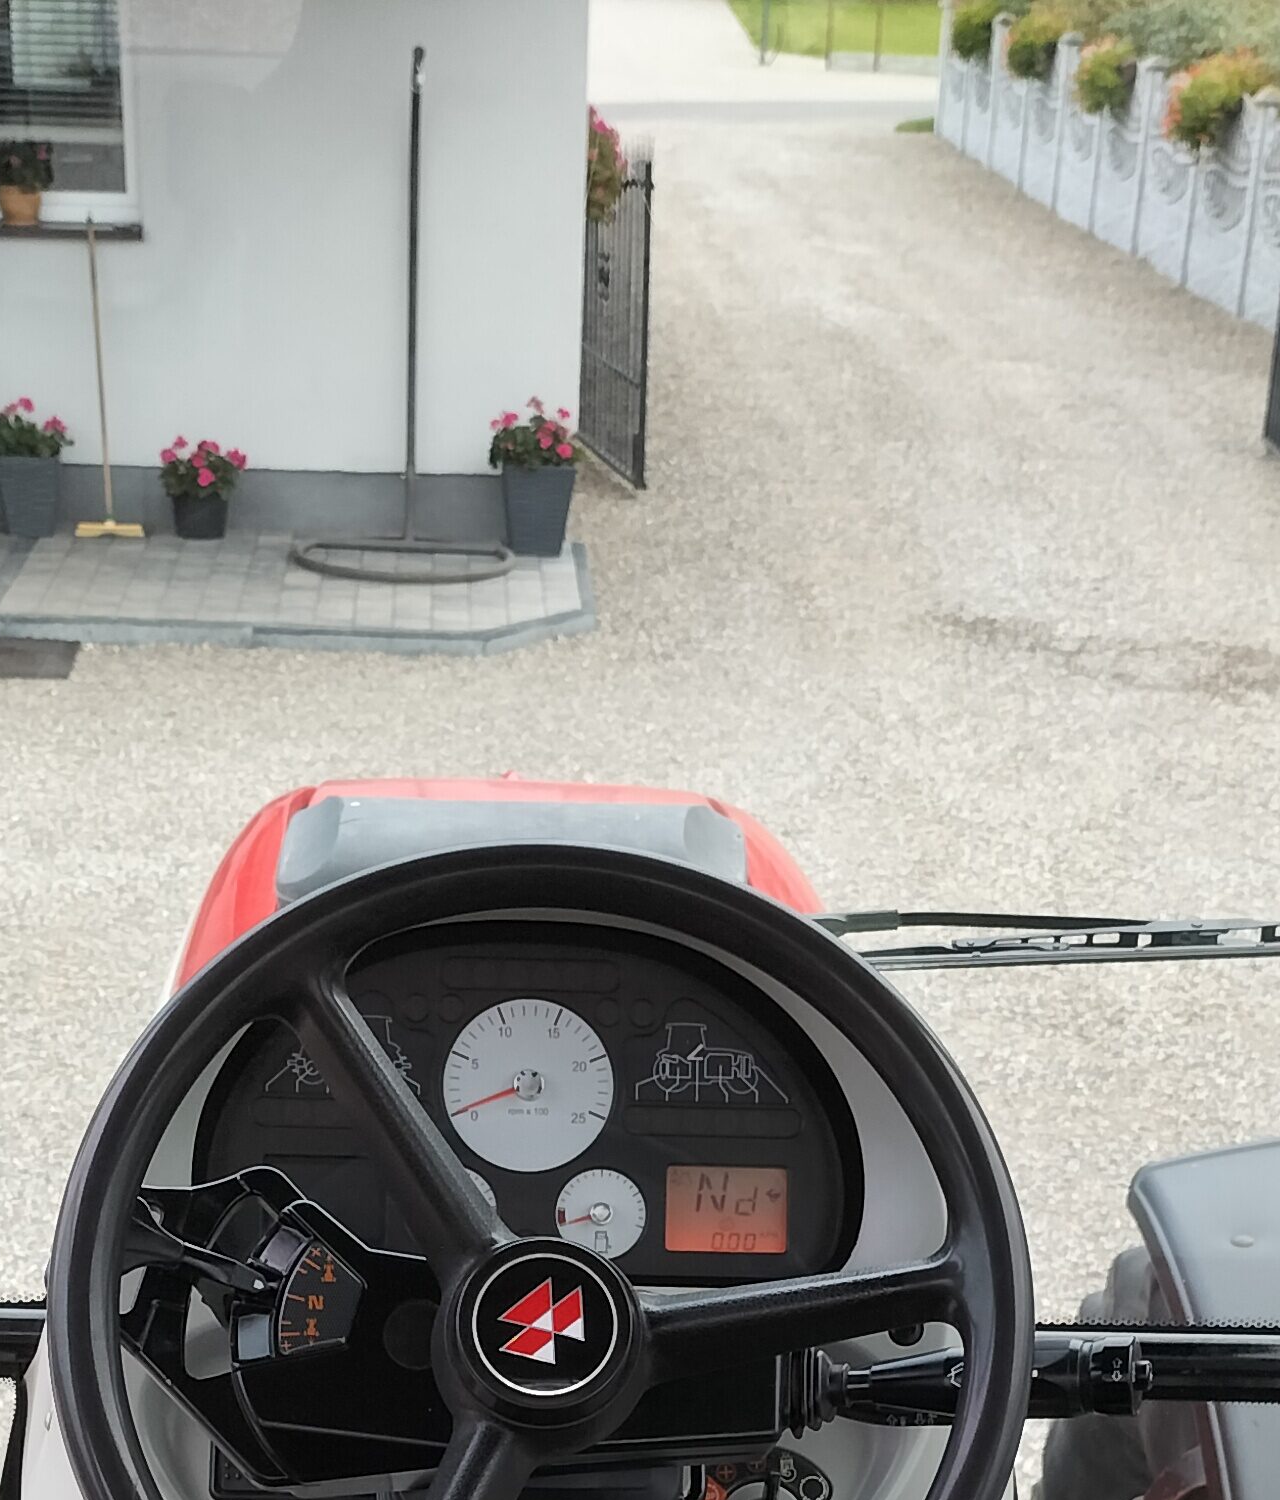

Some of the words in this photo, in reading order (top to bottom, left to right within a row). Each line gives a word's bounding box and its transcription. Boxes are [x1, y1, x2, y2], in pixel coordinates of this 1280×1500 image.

[498, 1027, 513, 1038] 10
[548, 1028, 560, 1039] 15
[471, 1058, 480, 1070] 5
[572, 1061, 587, 1073] 20
[470, 1110, 479, 1122] 0
[508, 1108, 524, 1117] rpm
[534, 1107, 549, 1116] 100
[571, 1113, 586, 1125] 25
[308, 1295, 324, 1310] N
